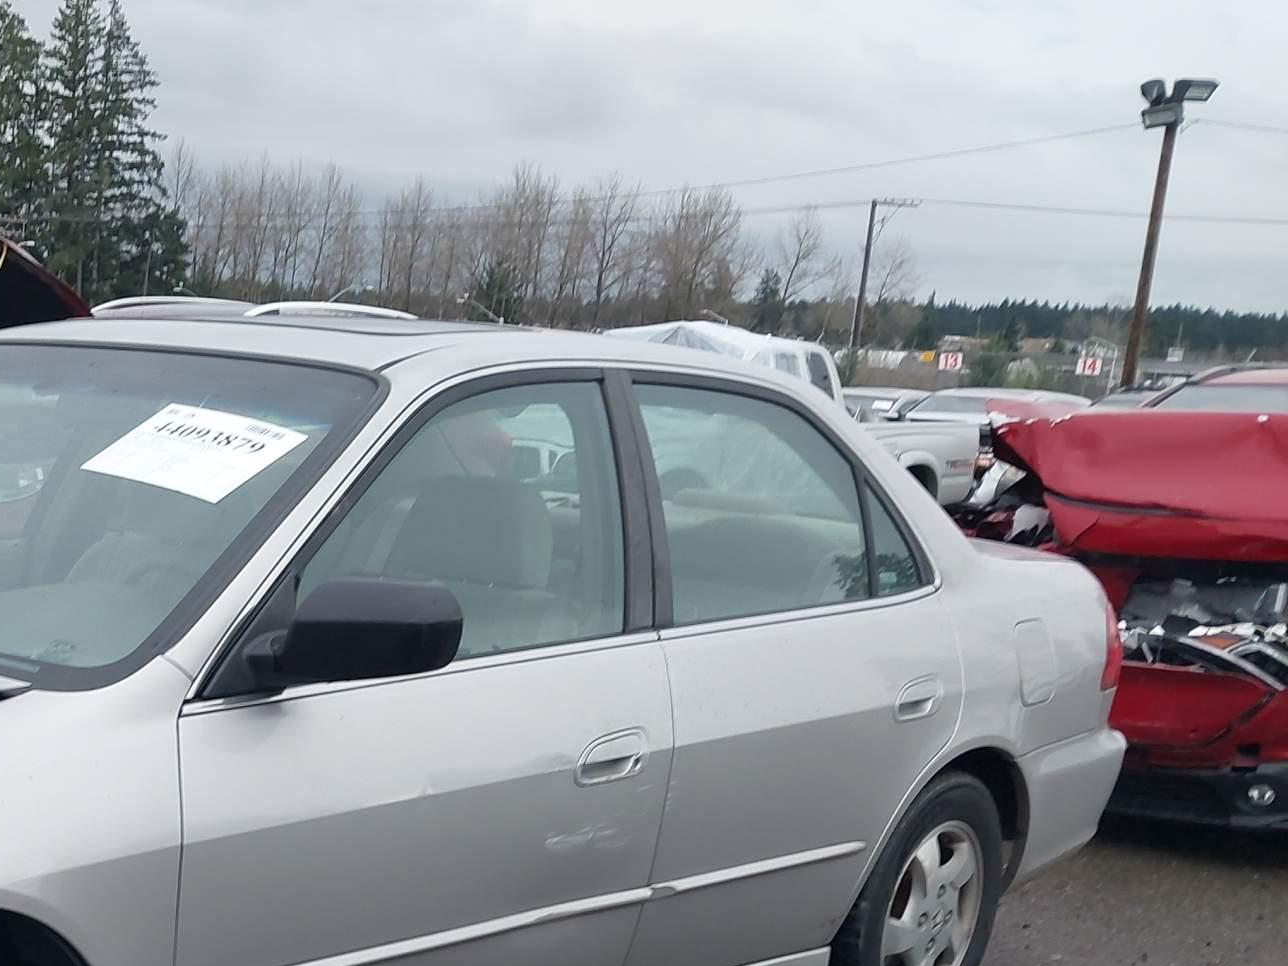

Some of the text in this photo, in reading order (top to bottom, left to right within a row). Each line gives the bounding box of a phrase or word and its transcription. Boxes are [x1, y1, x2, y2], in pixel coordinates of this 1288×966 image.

[943, 351, 960, 369] 13
[1080, 357, 1098, 374] 14
[154, 421, 266, 454] 44093879
